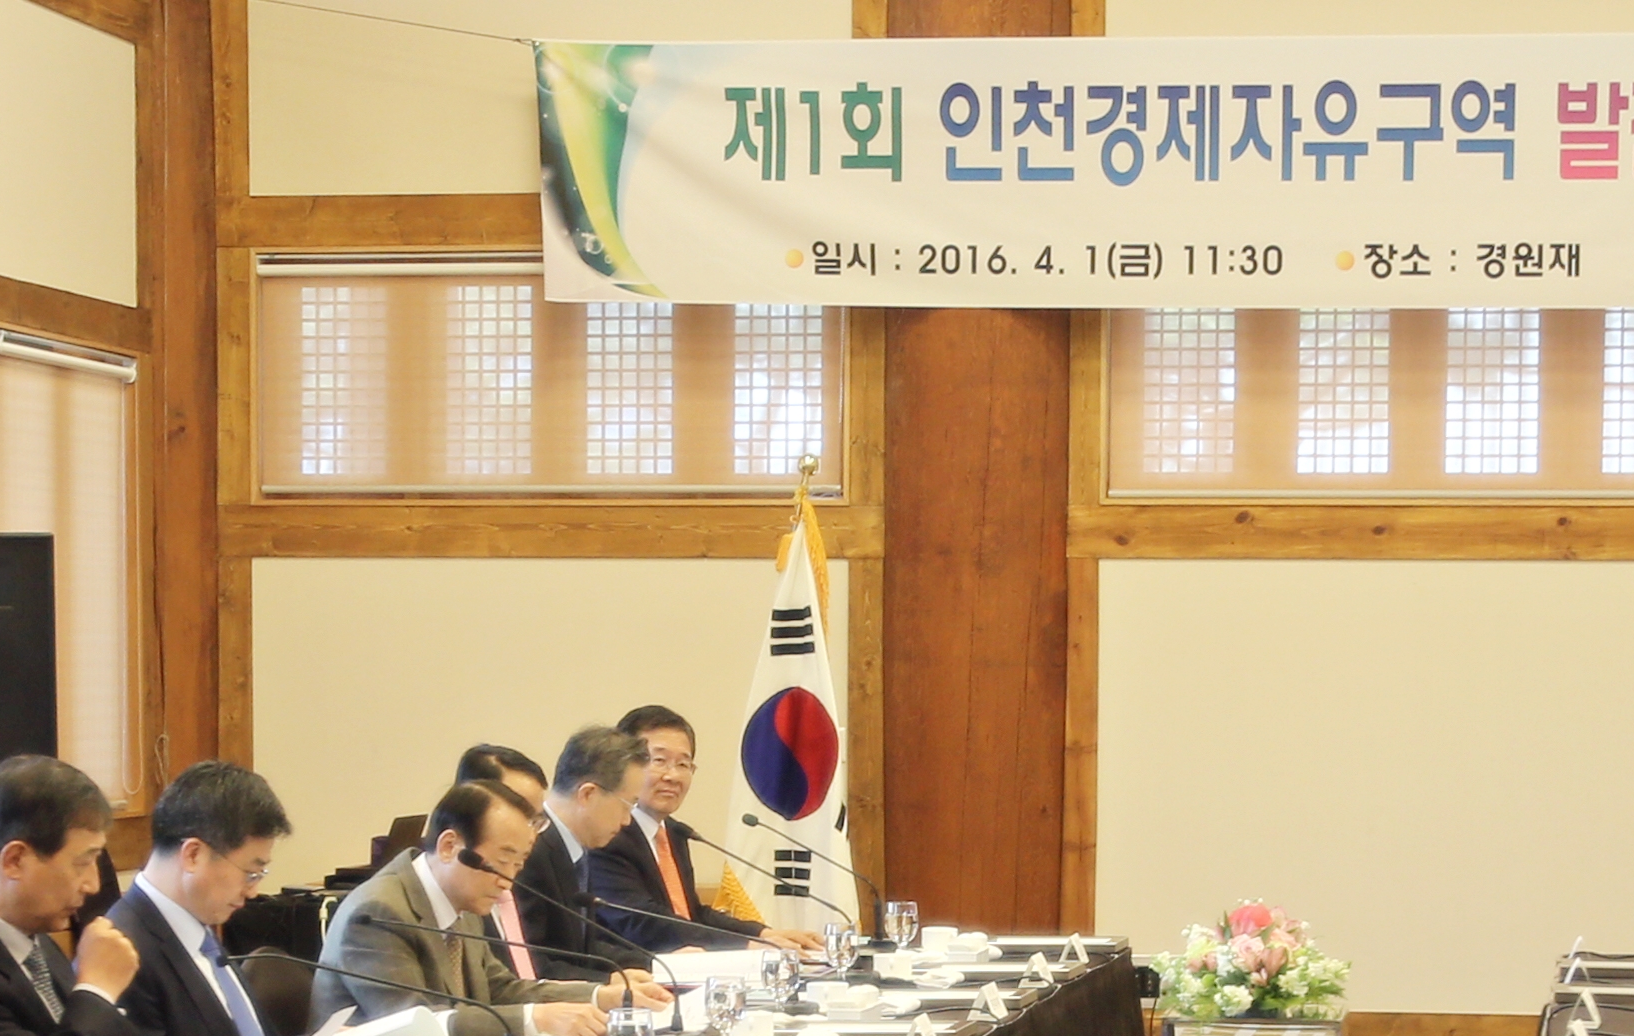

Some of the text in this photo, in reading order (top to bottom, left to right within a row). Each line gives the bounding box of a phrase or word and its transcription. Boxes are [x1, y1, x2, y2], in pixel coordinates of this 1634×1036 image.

[724, 81, 903, 183] 제1회
[939, 79, 1517, 187] 인천경제자유구역
[811, 240, 877, 277] 일시
[918, 243, 1017, 275] 2016.
[1033, 244, 1065, 275] 4.
[1085, 241, 1163, 280] 1(금)
[1183, 244, 1283, 276] 11:30
[1364, 243, 1432, 280] 장소
[1476, 242, 1581, 280] 경원재
